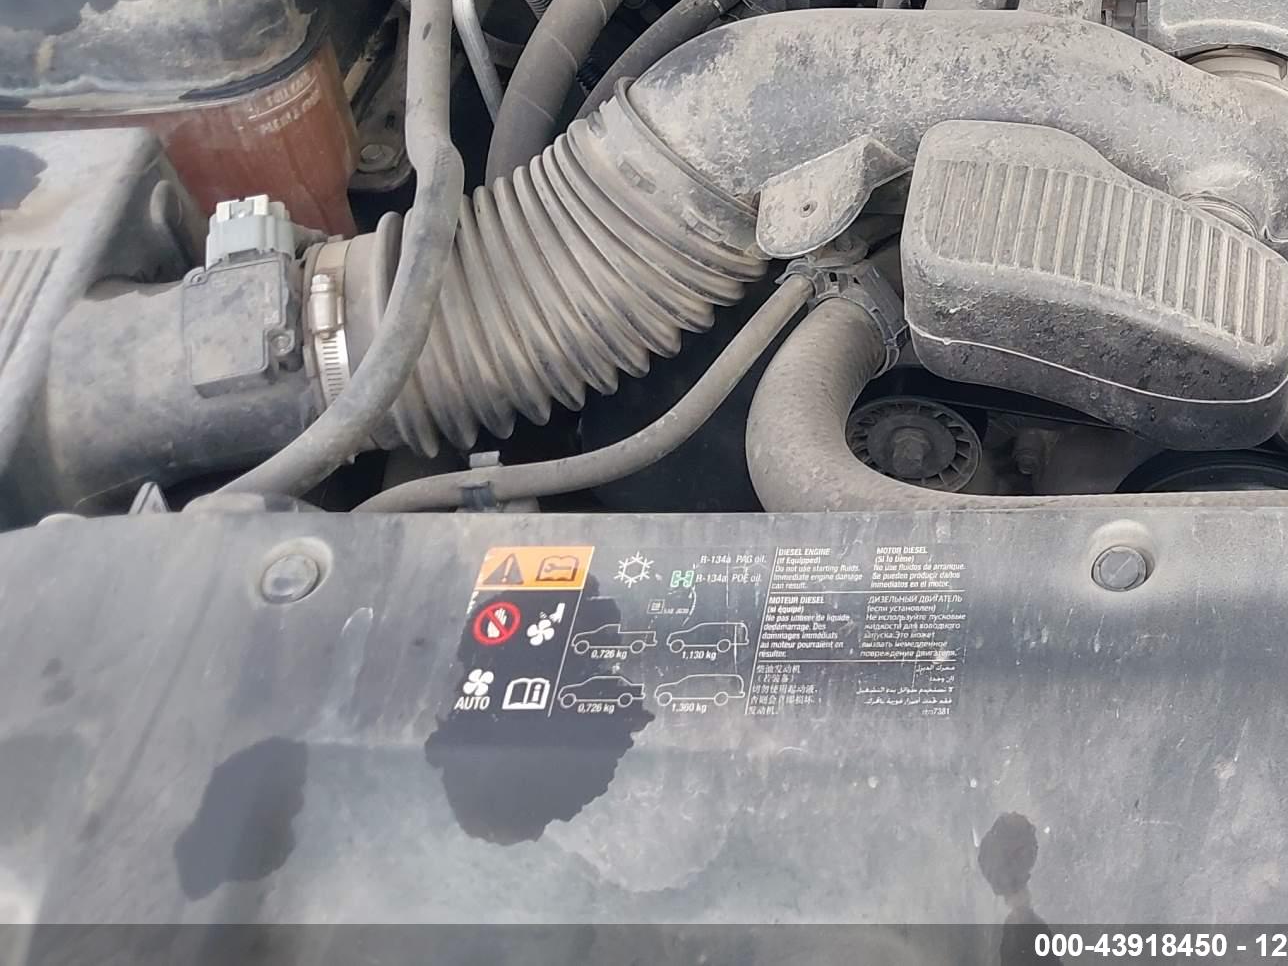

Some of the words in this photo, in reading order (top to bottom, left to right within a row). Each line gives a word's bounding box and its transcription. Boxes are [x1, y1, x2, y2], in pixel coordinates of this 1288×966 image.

[904, 546, 928, 554] DIESEL
[700, 555, 731, 564] R-134a
[736, 555, 753, 563] PAG
[812, 565, 838, 573] starting
[696, 574, 727, 583] R-134a
[731, 574, 749, 583] POE
[835, 573, 863, 581] damage
[909, 572, 938, 580] producir
[800, 596, 824, 604] DIESEL
[868, 595, 917, 604] ДИЗЕЛЬНЫЙ
[919, 595, 963, 603] ДВИГАТЕЛЬ
[889, 604, 936, 613] установлен)
[762, 632, 800, 640] dommages
[616, 650, 627, 659] kg
[706, 650, 716, 661] kg
[454, 696, 490, 710] AUTO
[603, 703, 615, 714] kg
[696, 703, 707, 714] kg
